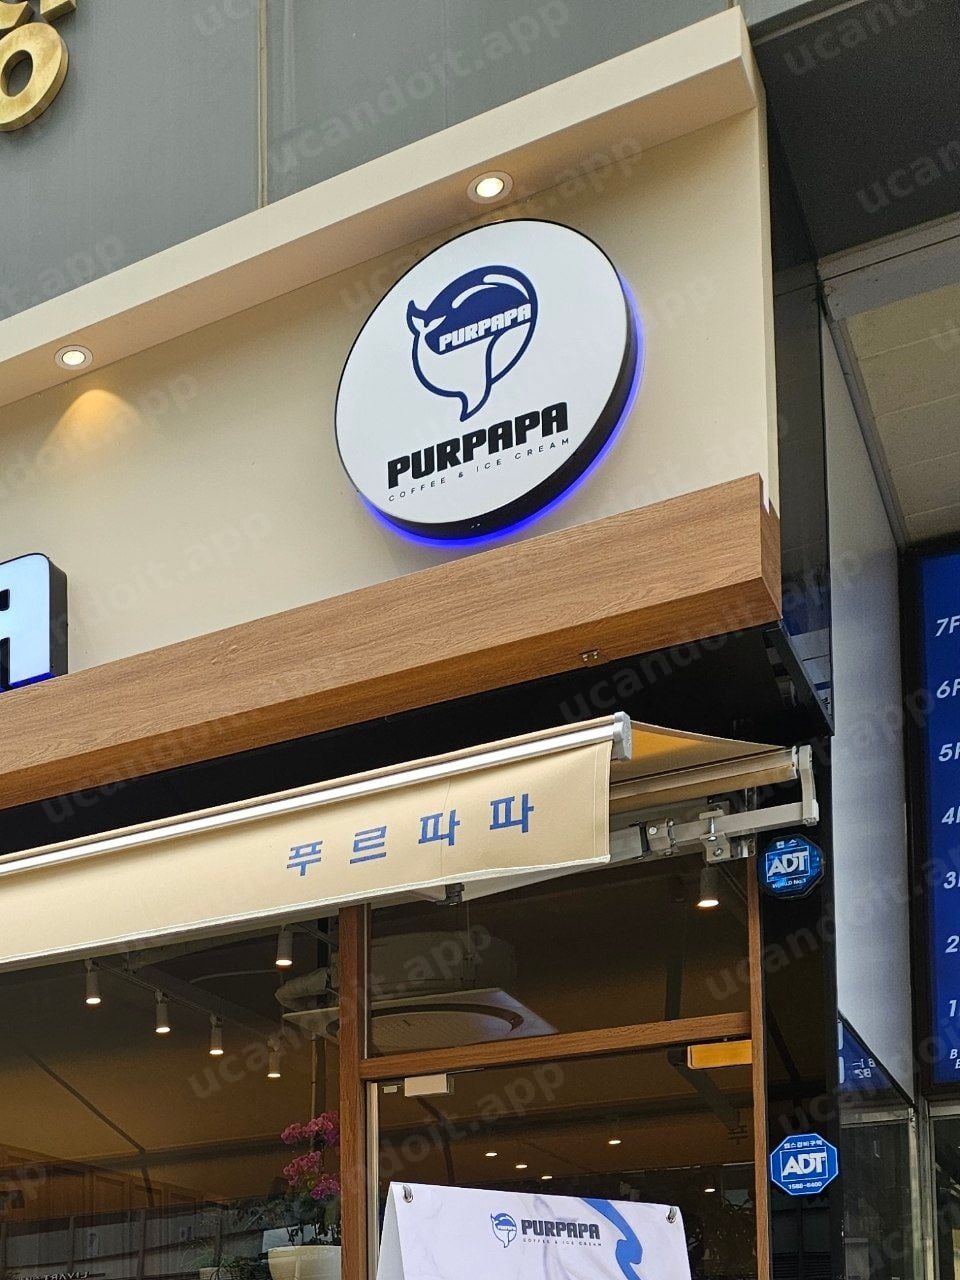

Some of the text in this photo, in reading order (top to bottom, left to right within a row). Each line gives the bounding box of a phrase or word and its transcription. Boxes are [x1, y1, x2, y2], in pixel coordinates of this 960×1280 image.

[439, 303, 532, 352] PURPAPA
[387, 401, 569, 489] PURPAPA
[388, 477, 446, 502] COFFEE
[476, 458, 502, 472] ICE
[514, 438, 570, 459] CREAM
[935, 615, 960, 637] 7F
[942, 806, 960, 825] 4
[768, 851, 809, 876] ADT
[782, 1152, 827, 1176] ADT
[520, 1219, 601, 1240] PURPAPA
